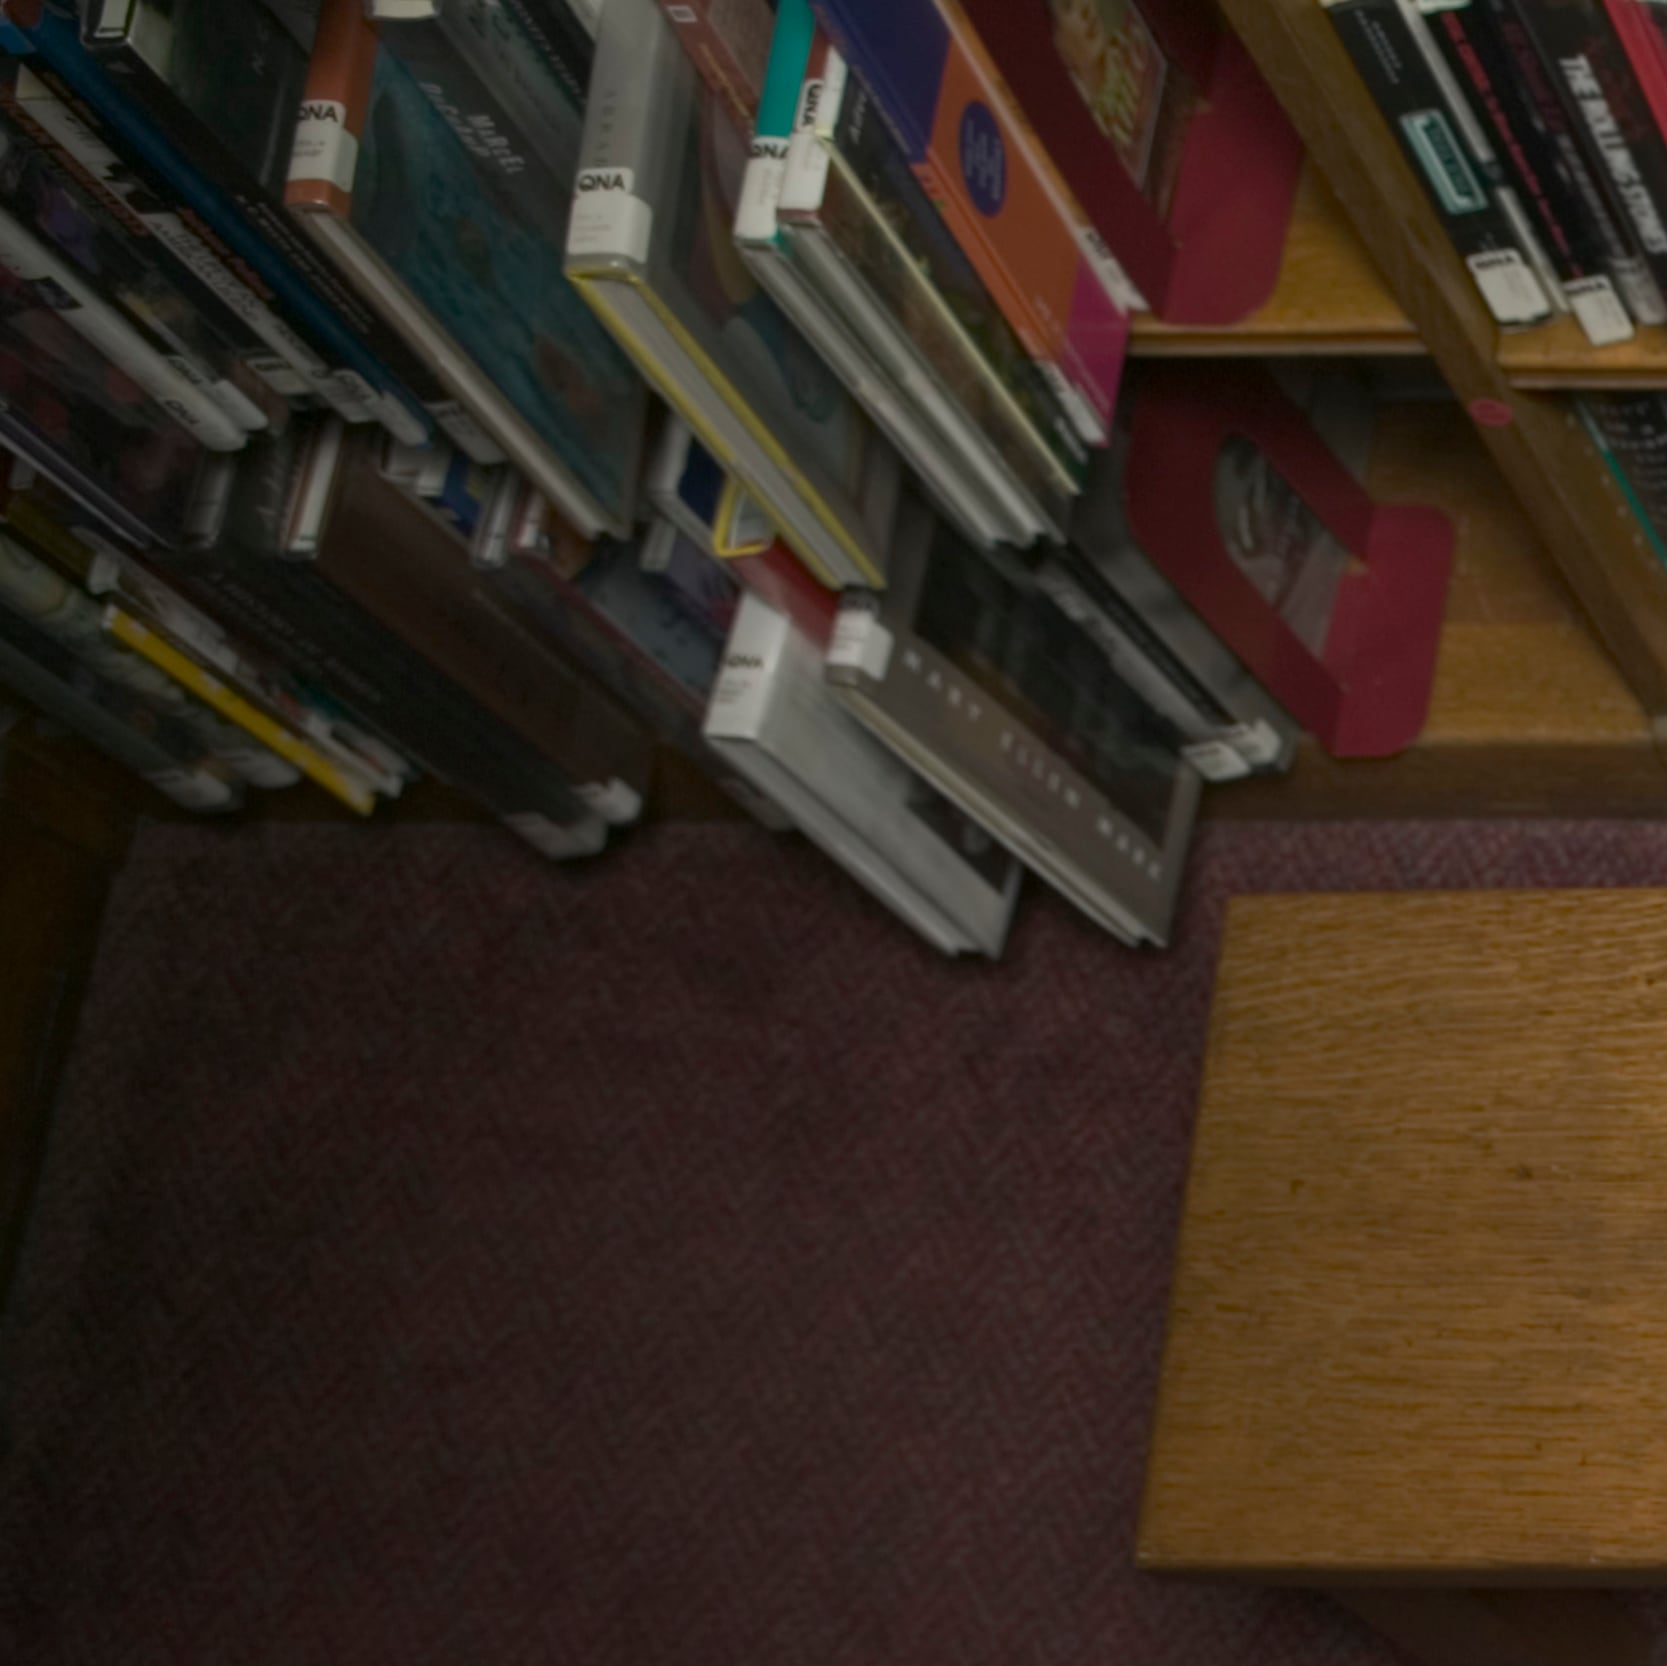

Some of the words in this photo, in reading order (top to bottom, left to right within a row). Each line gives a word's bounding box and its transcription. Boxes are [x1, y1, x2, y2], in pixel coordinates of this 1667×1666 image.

[1557, 53, 1598, 104] THE
[1577, 98, 1641, 187] ROLLING
[904, 651, 985, 722] MARY
[1001, 731, 1083, 809] ELLEN
[1097, 817, 1165, 881] MARK
